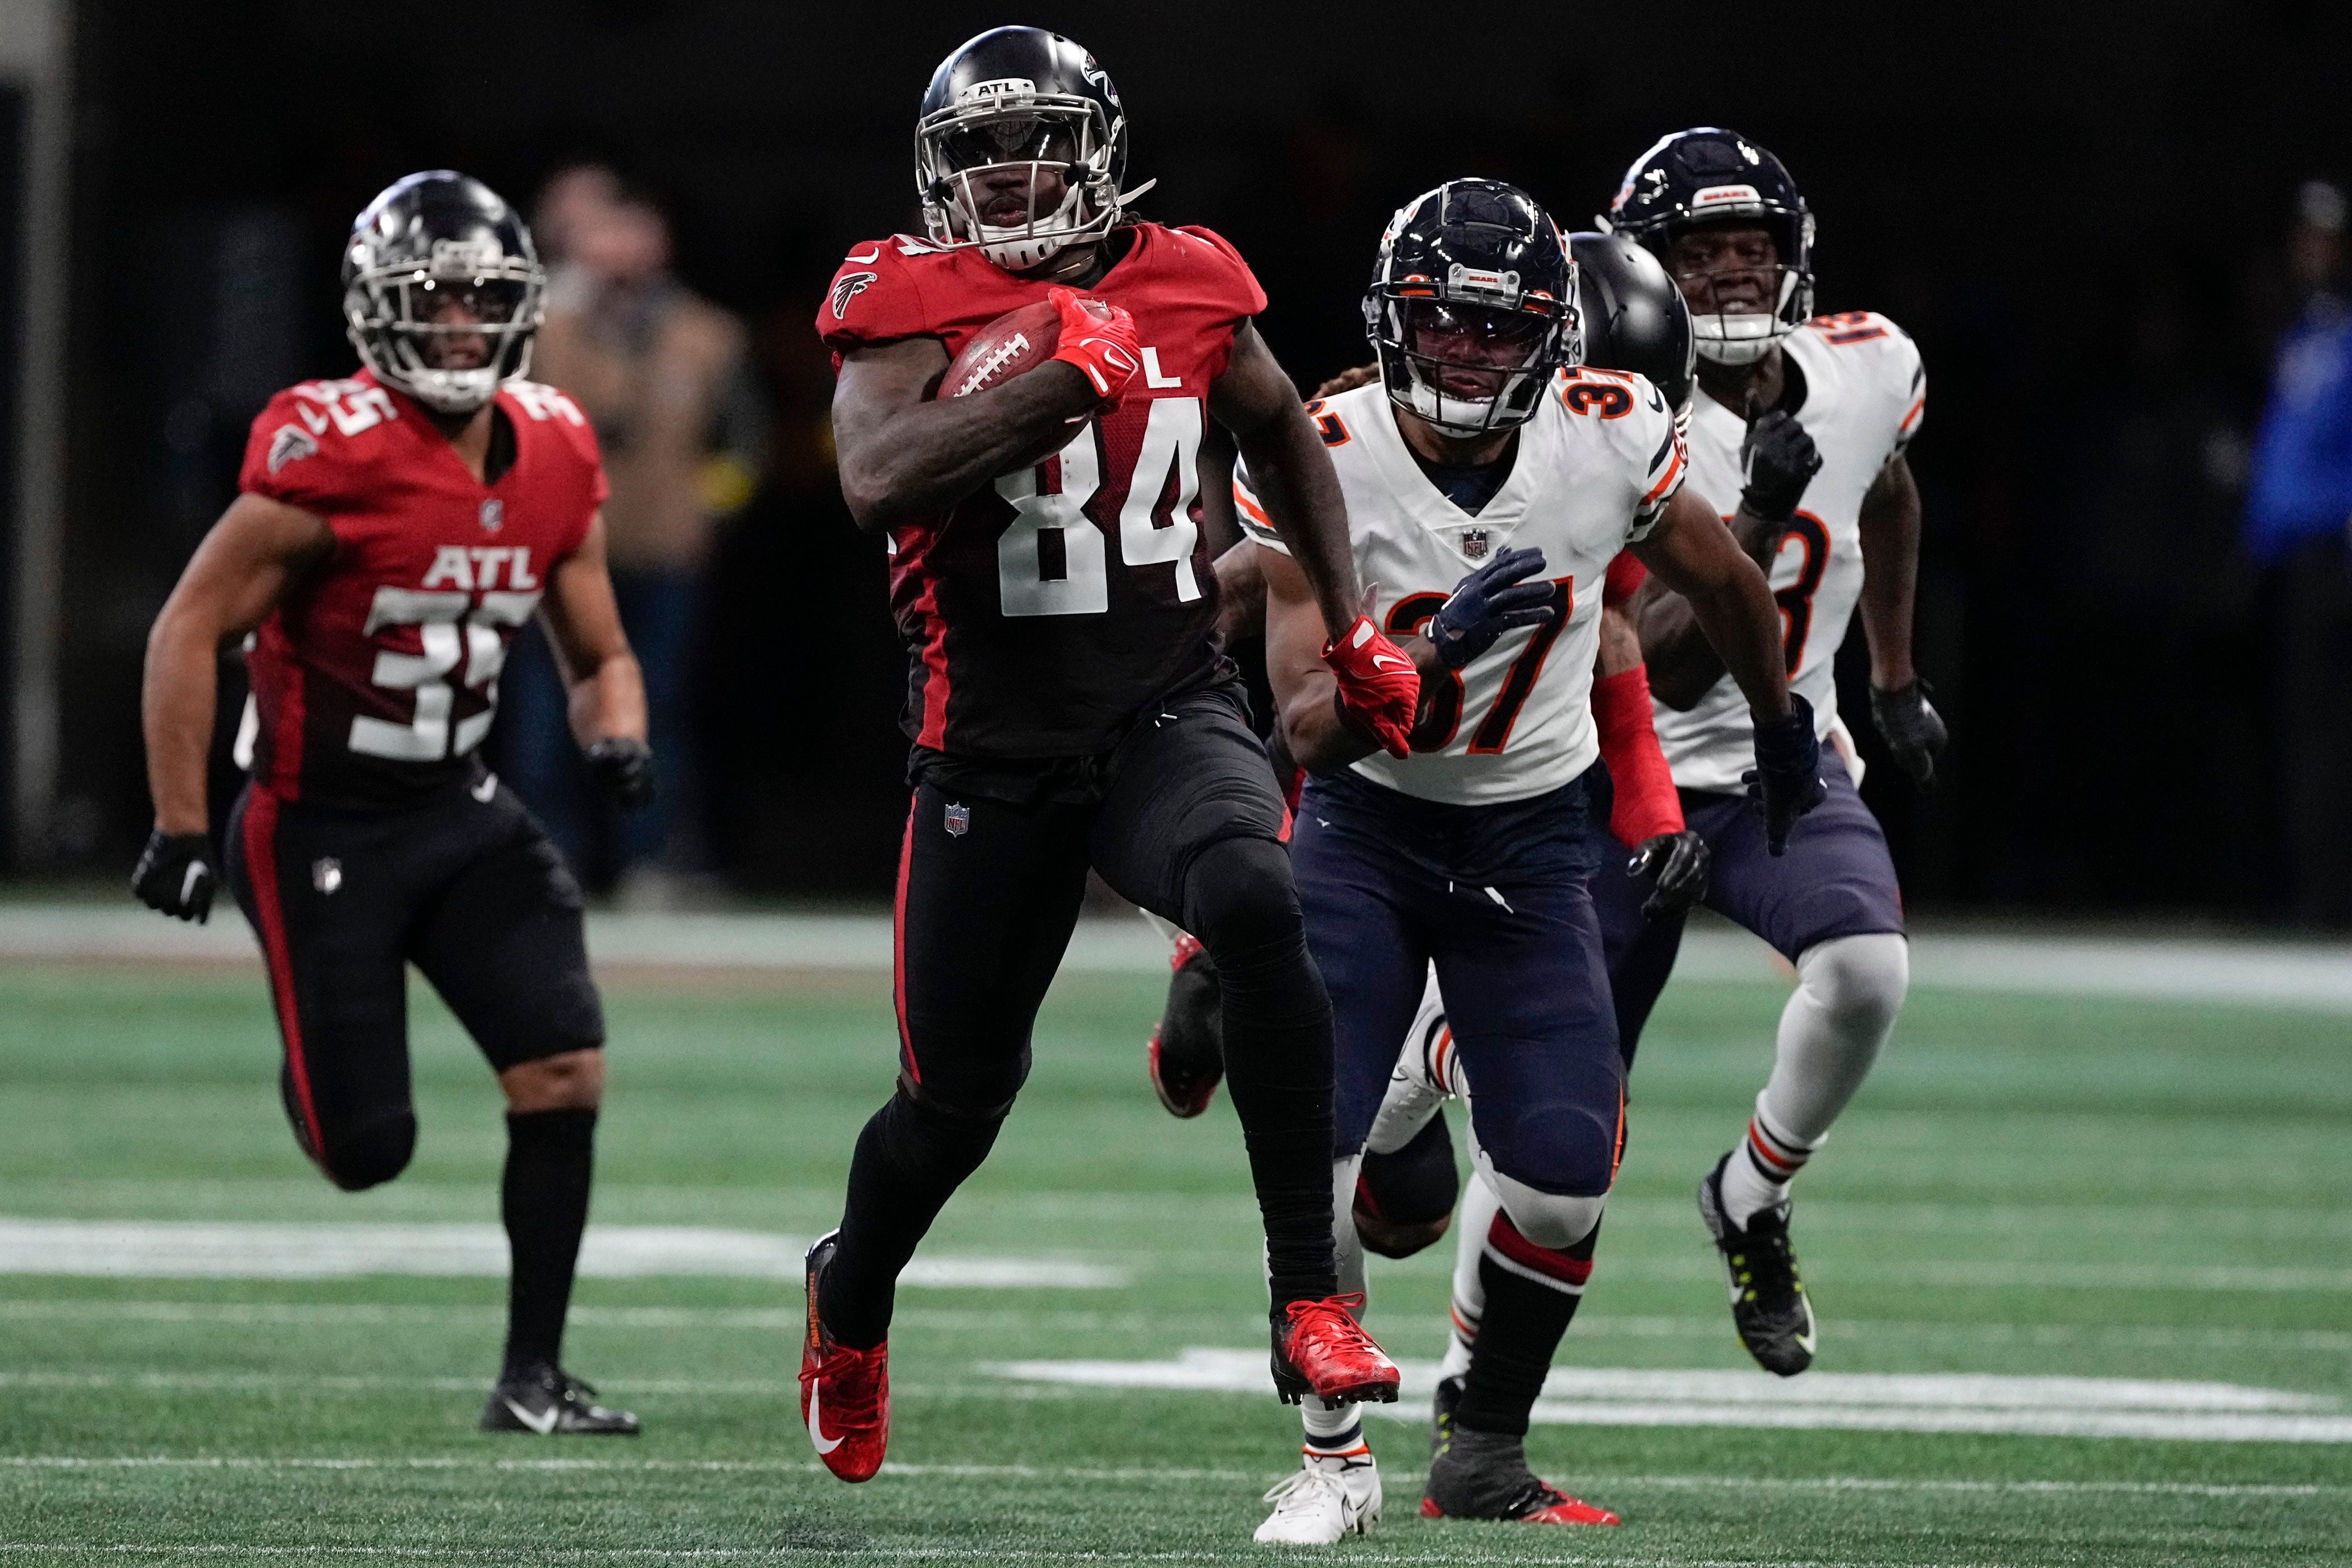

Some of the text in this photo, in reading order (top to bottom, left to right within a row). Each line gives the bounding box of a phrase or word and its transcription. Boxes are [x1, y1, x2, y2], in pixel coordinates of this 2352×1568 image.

[978, 82, 1014, 96] ATL
[994, 397, 1204, 617] 84
[422, 546, 537, 589] ATL
